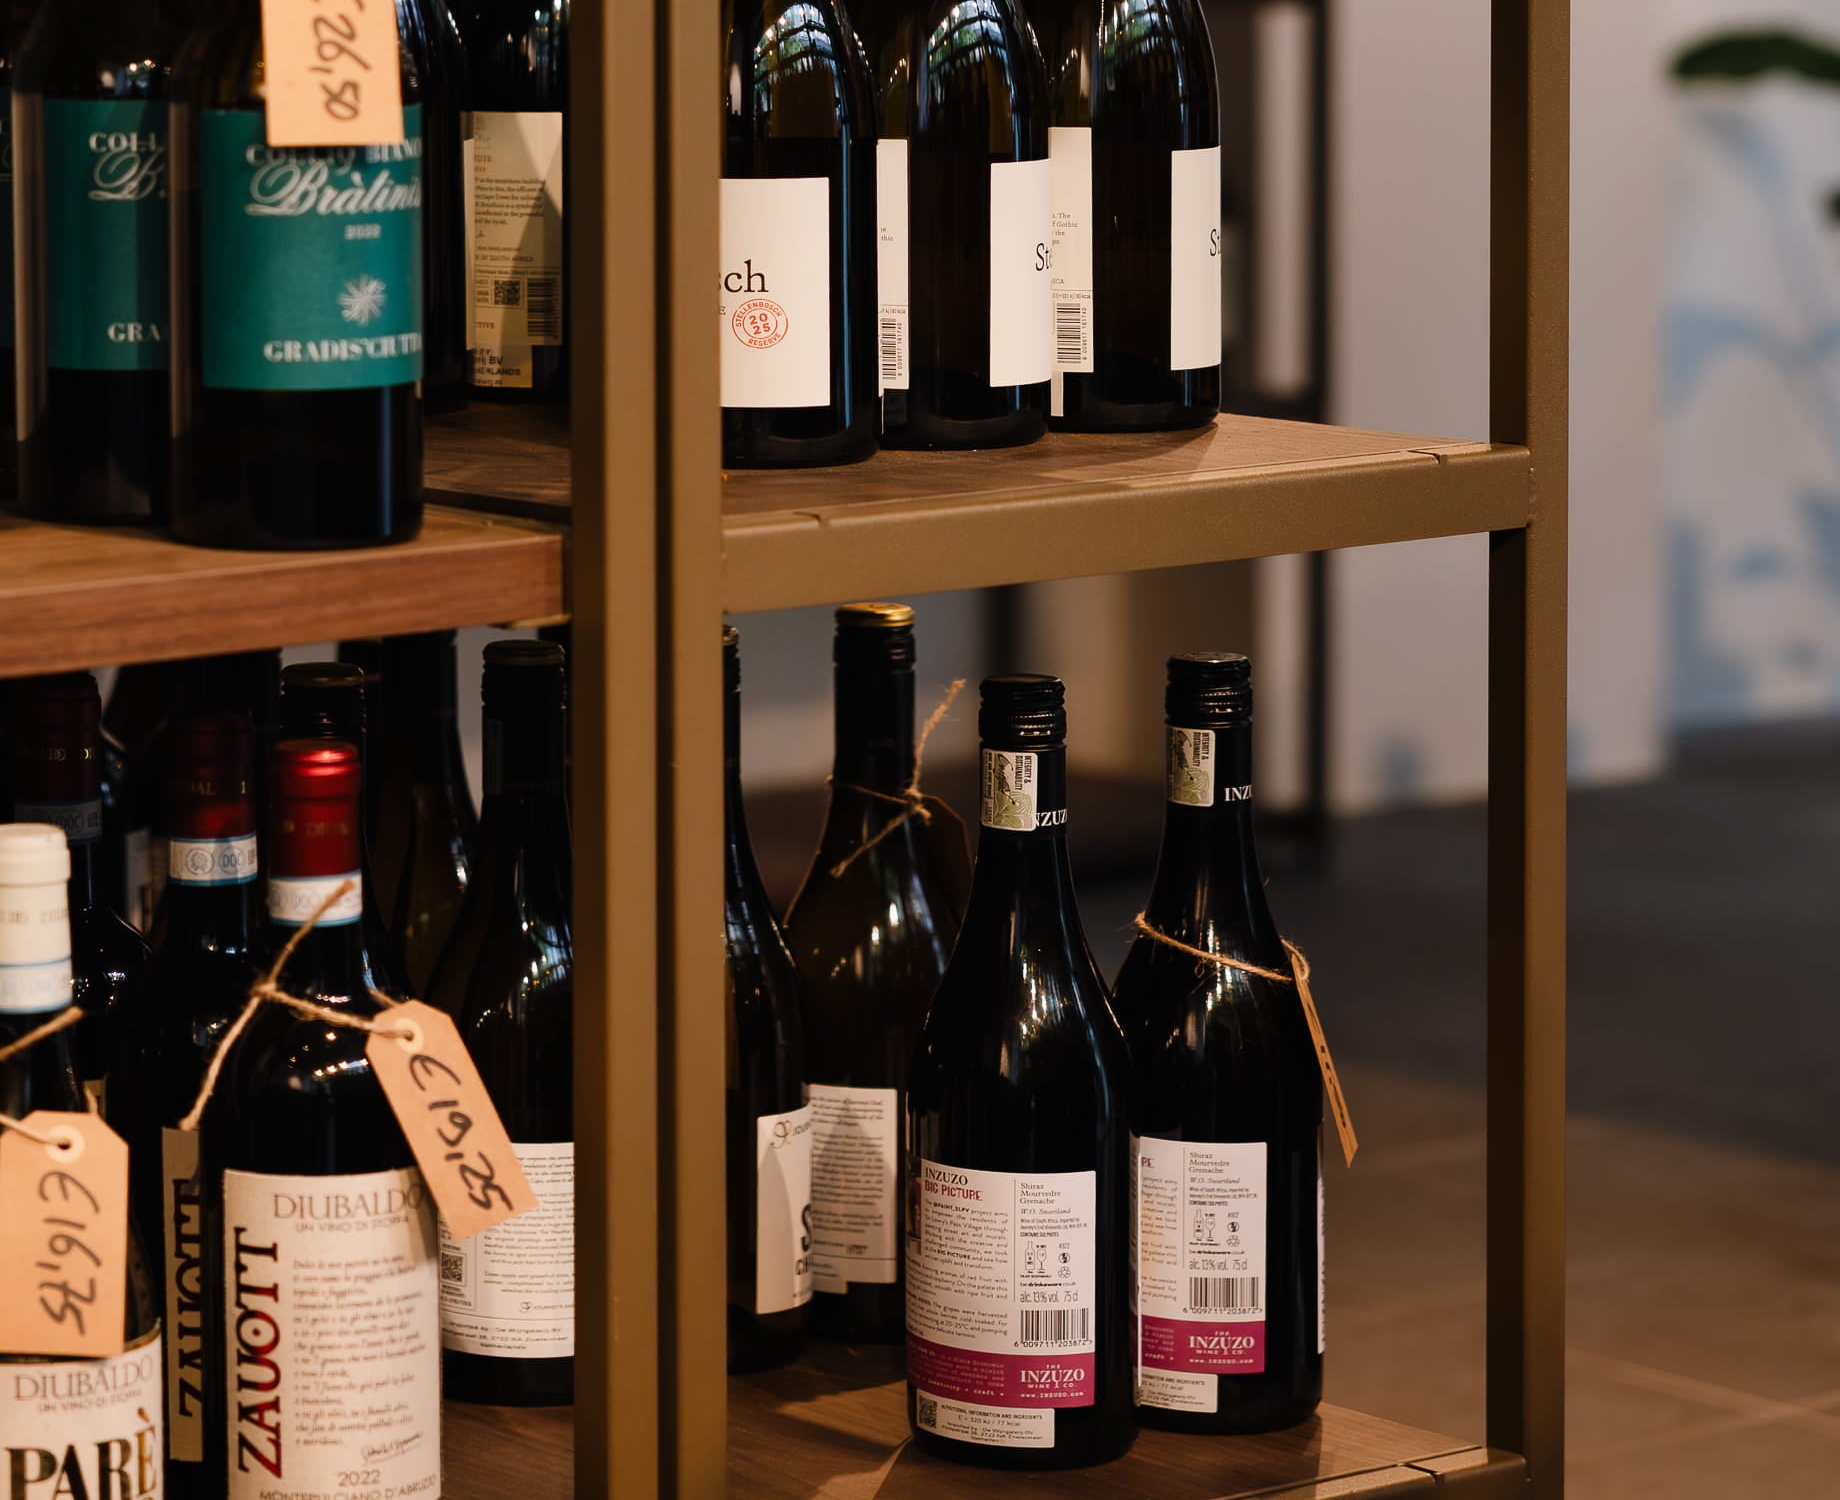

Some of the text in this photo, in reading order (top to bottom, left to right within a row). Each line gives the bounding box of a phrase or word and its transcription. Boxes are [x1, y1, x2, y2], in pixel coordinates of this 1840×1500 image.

[736, 301, 782, 327] STELLENBOSCH
[748, 332, 781, 347] RESERVE
[409, 1054, 513, 1211] €19,25
[925, 1167, 968, 1186] INZUZO
[1188, 1166, 1224, 1174] Grenache
[924, 1180, 983, 1201] BIG PICTURE
[1020, 1182, 1044, 1190] Shiraz
[1020, 1190, 1061, 1198] Mourvedre
[1020, 1197, 1055, 1205] Grenache
[963, 1221, 982, 1231] Village
[1189, 1335, 1255, 1349] INZUZO
[234, 1227, 282, 1479] ZAUOTT
[1020, 1368, 1085, 1384] INZUZO
[338, 1471, 381, 1487] 2022
